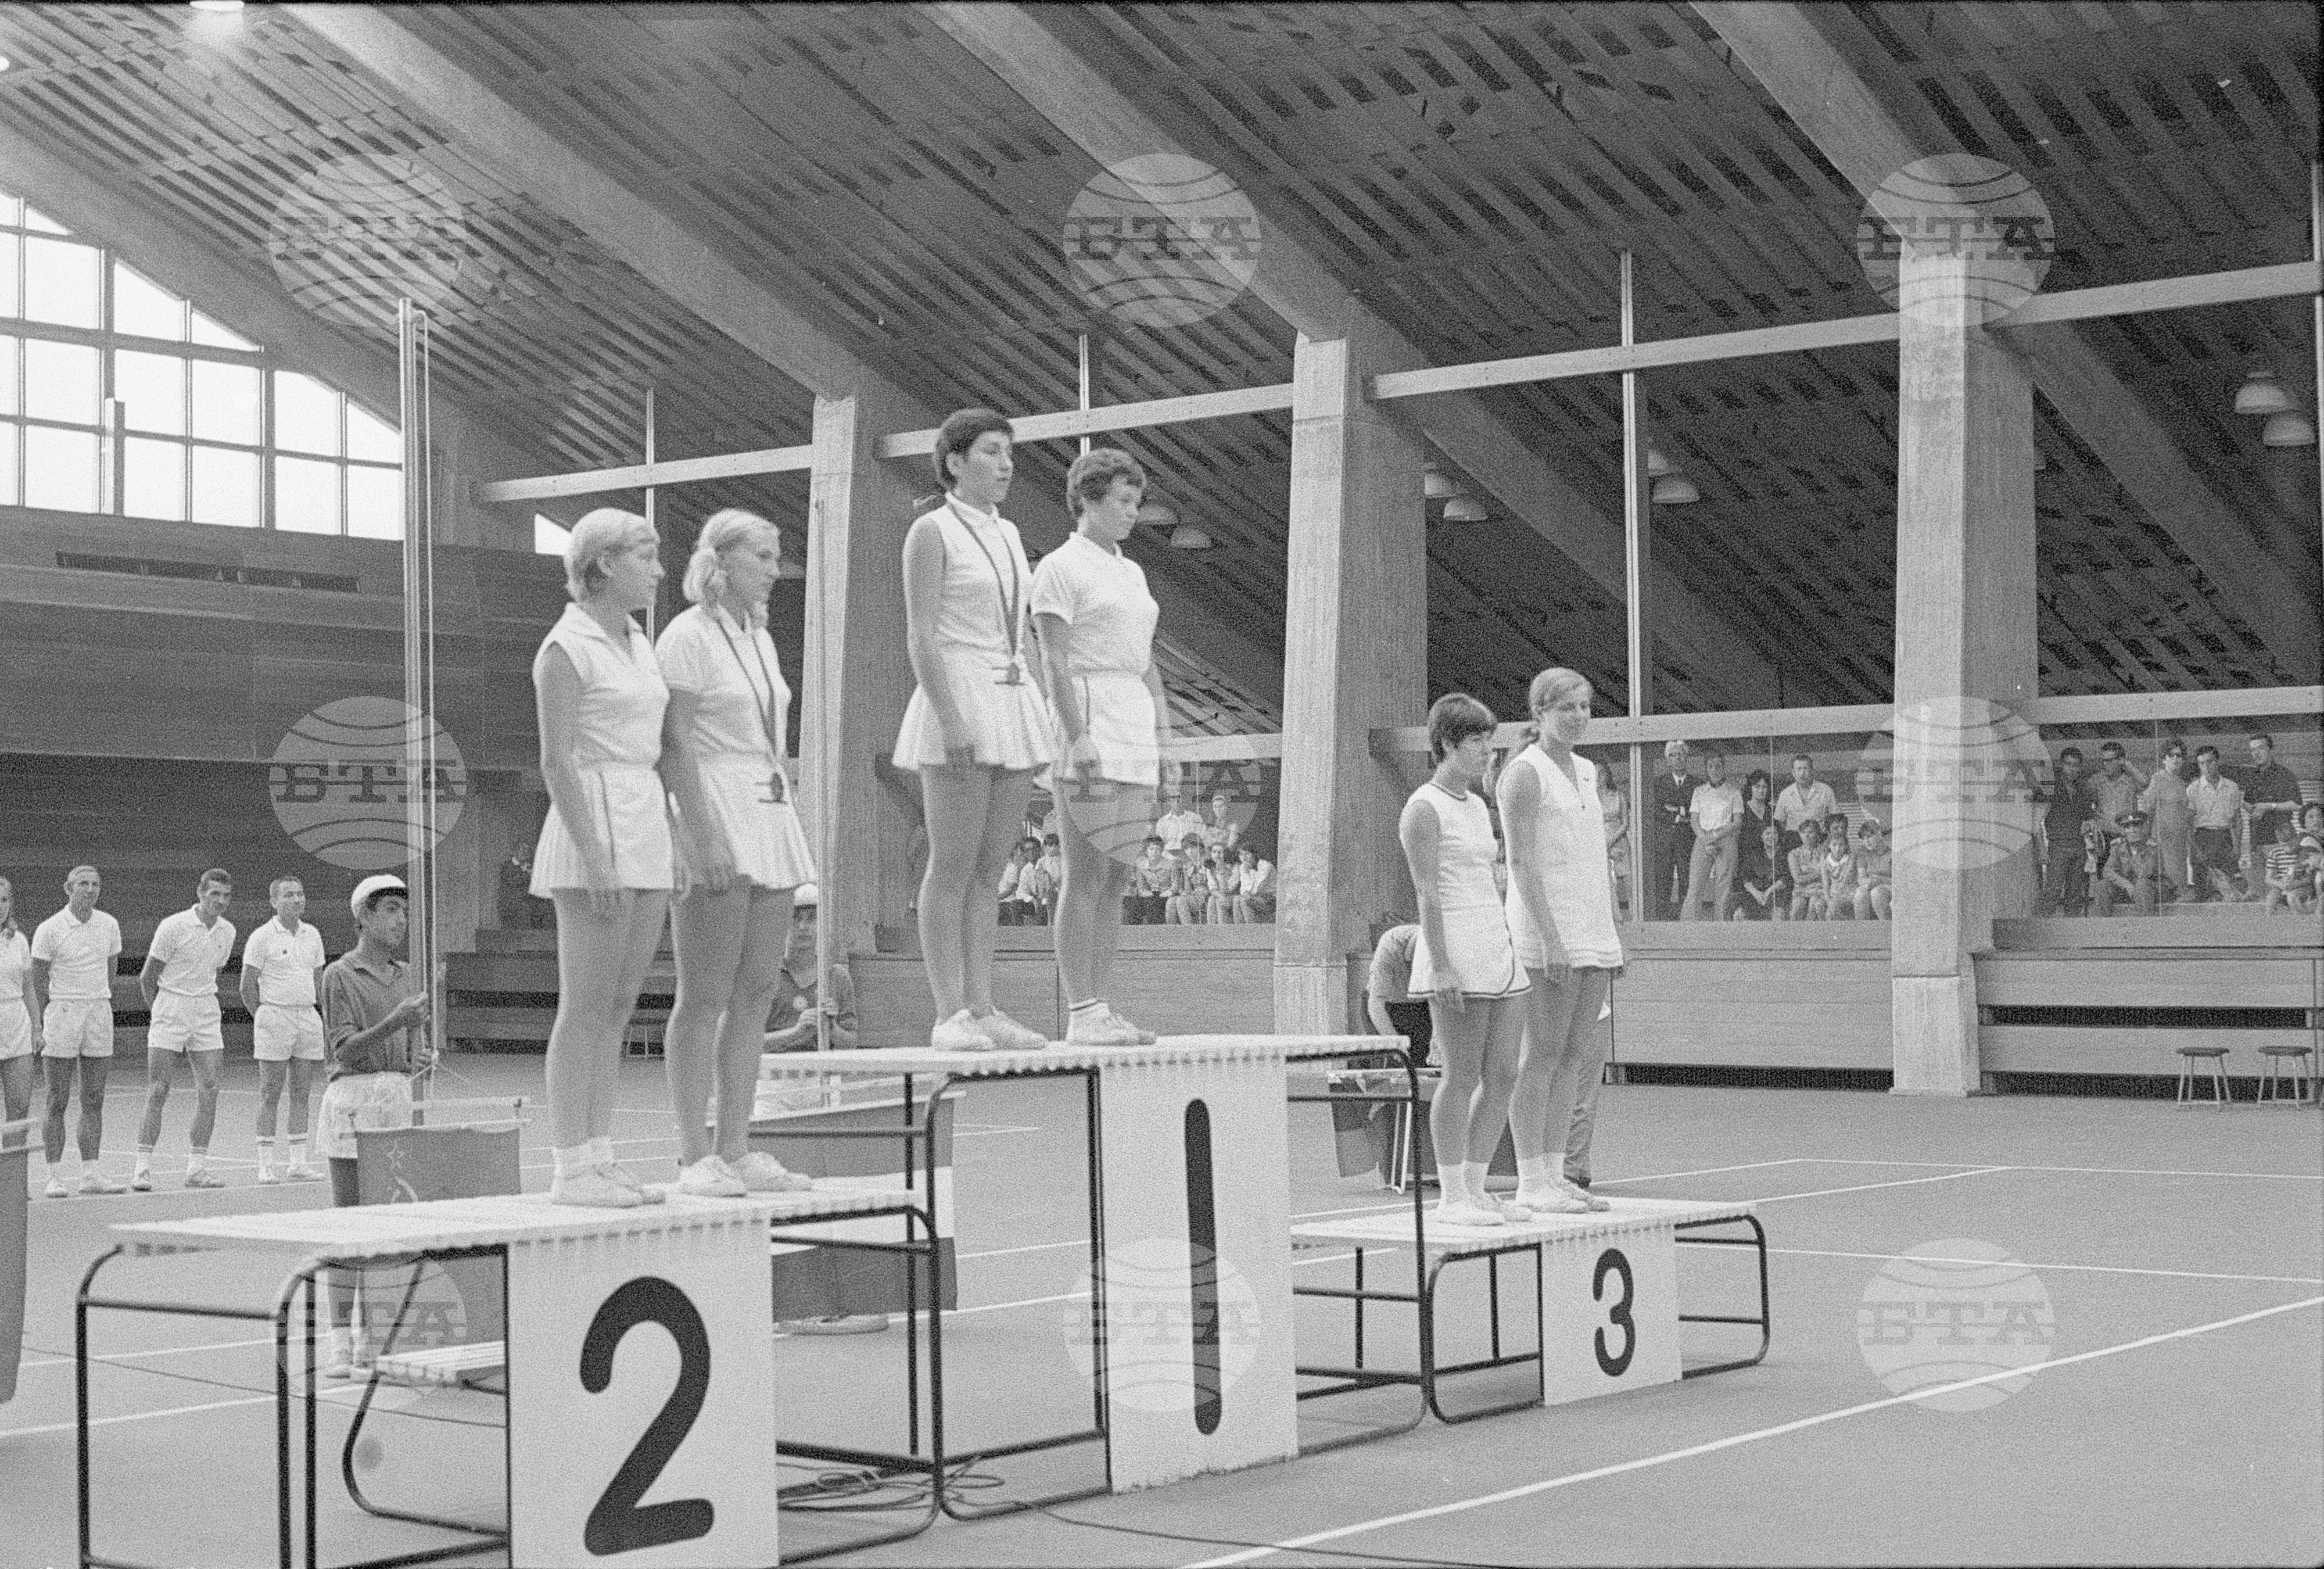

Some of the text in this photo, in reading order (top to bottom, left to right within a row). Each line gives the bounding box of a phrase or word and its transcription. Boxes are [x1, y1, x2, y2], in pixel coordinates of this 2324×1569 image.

[1185, 1098, 1221, 1435] 1
[1593, 1249, 1636, 1377] 3
[580, 1276, 715, 1556] 2
